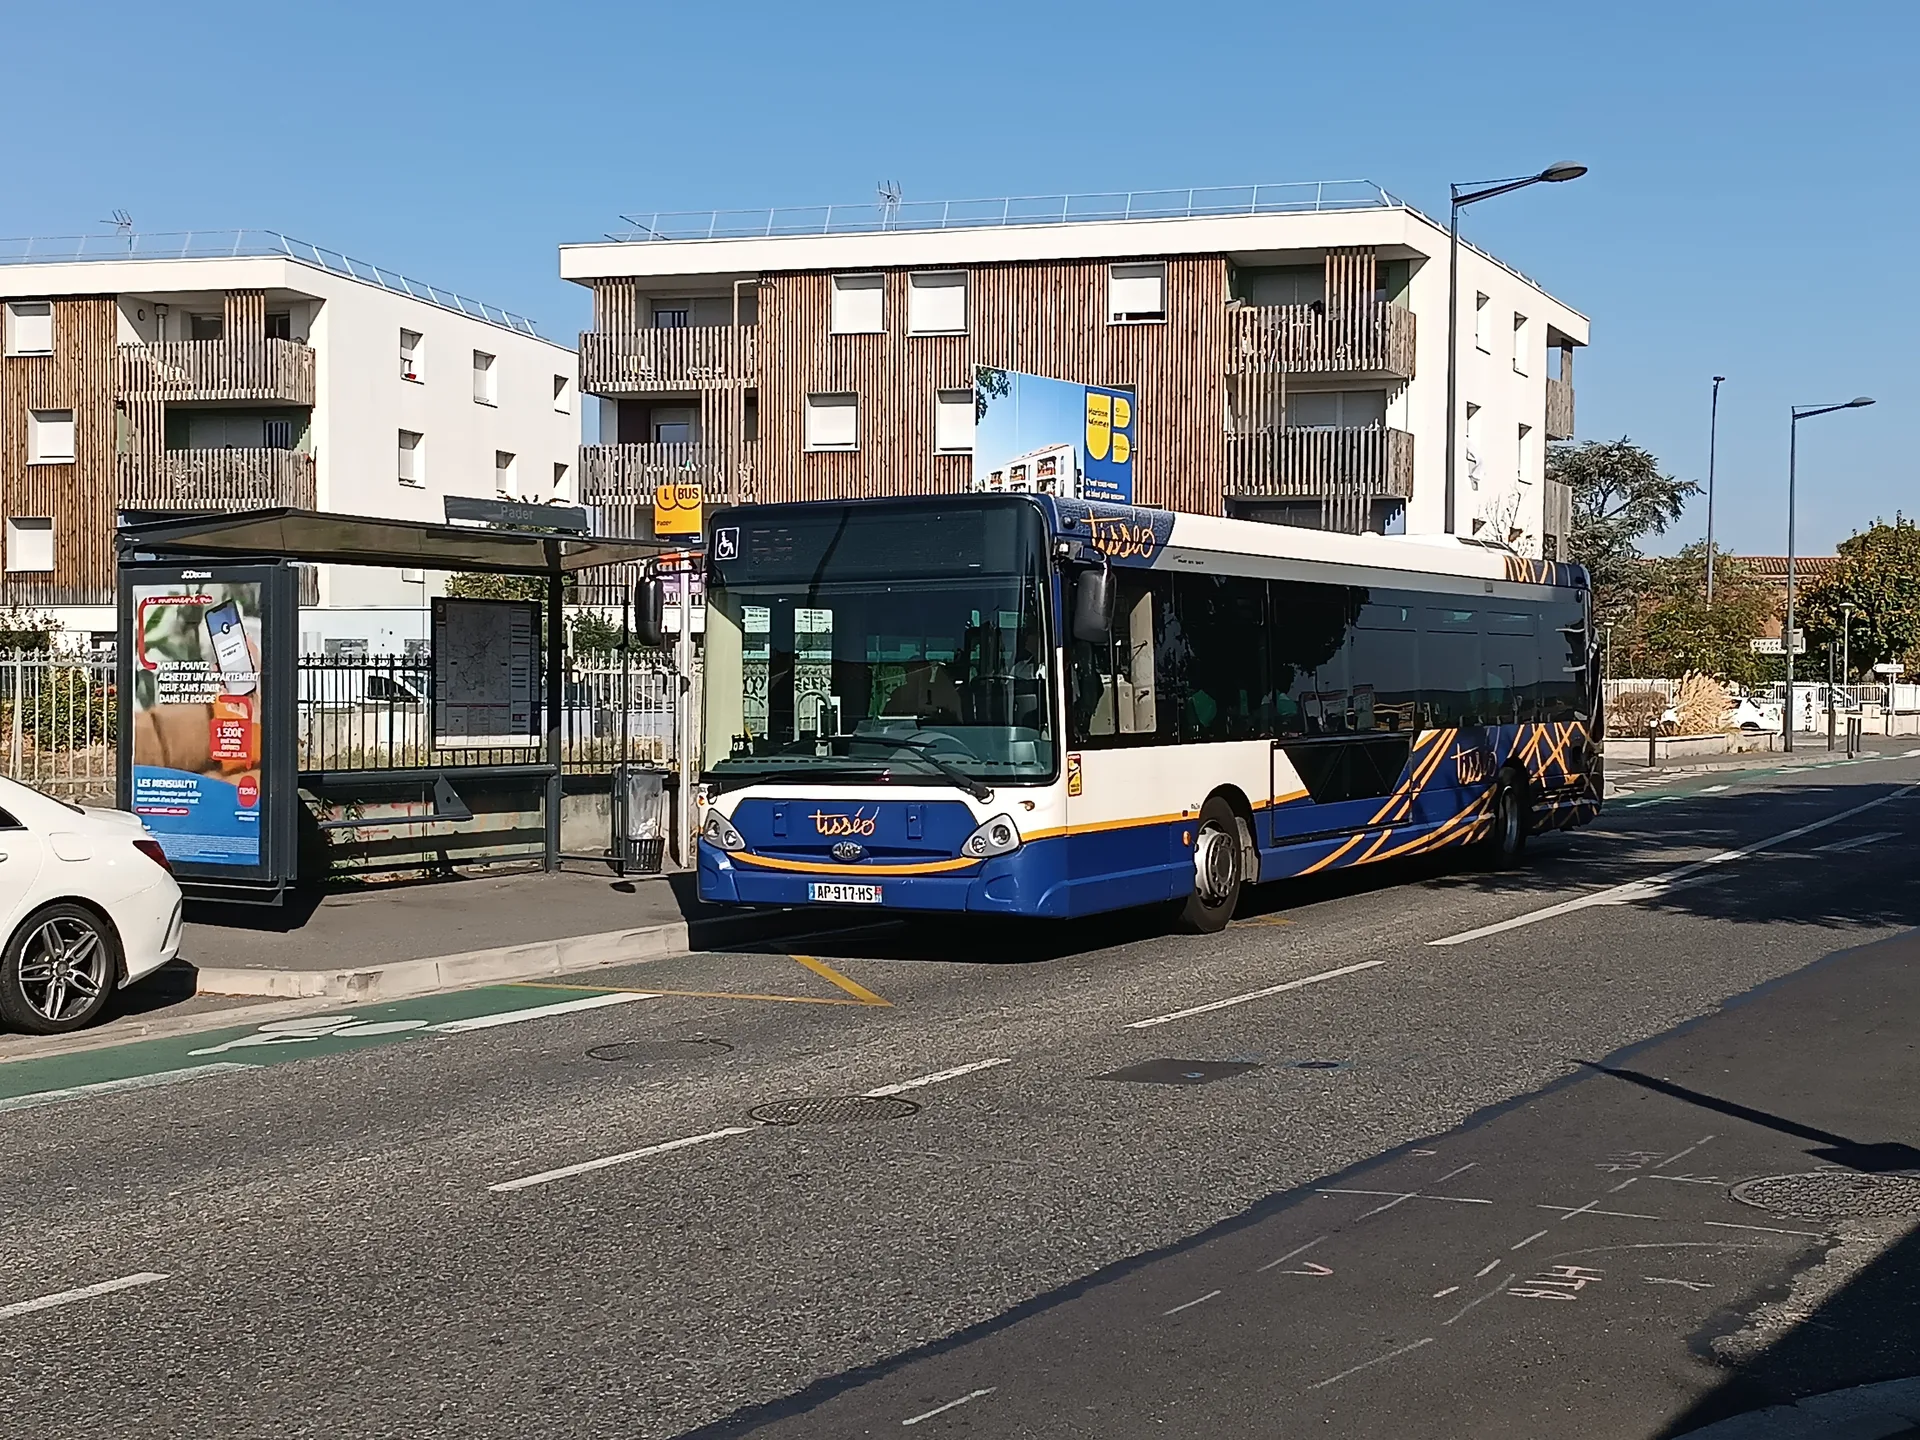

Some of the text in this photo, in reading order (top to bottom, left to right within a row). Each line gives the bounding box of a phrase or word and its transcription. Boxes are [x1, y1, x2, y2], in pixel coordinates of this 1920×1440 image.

[663, 487, 699, 500] L BUS
[500, 505, 534, 520] Pader
[158, 661, 210, 671] VOUS POUVEZ
[157, 672, 260, 682] ACHETER UN APPARTEMENT
[158, 683, 179, 692] NEUF
[179, 683, 199, 693] SANS
[159, 693, 216, 704] DANS LE ROUGE
[808, 805, 880, 836] tisséo
[817, 885, 874, 901] AP-917-HS
